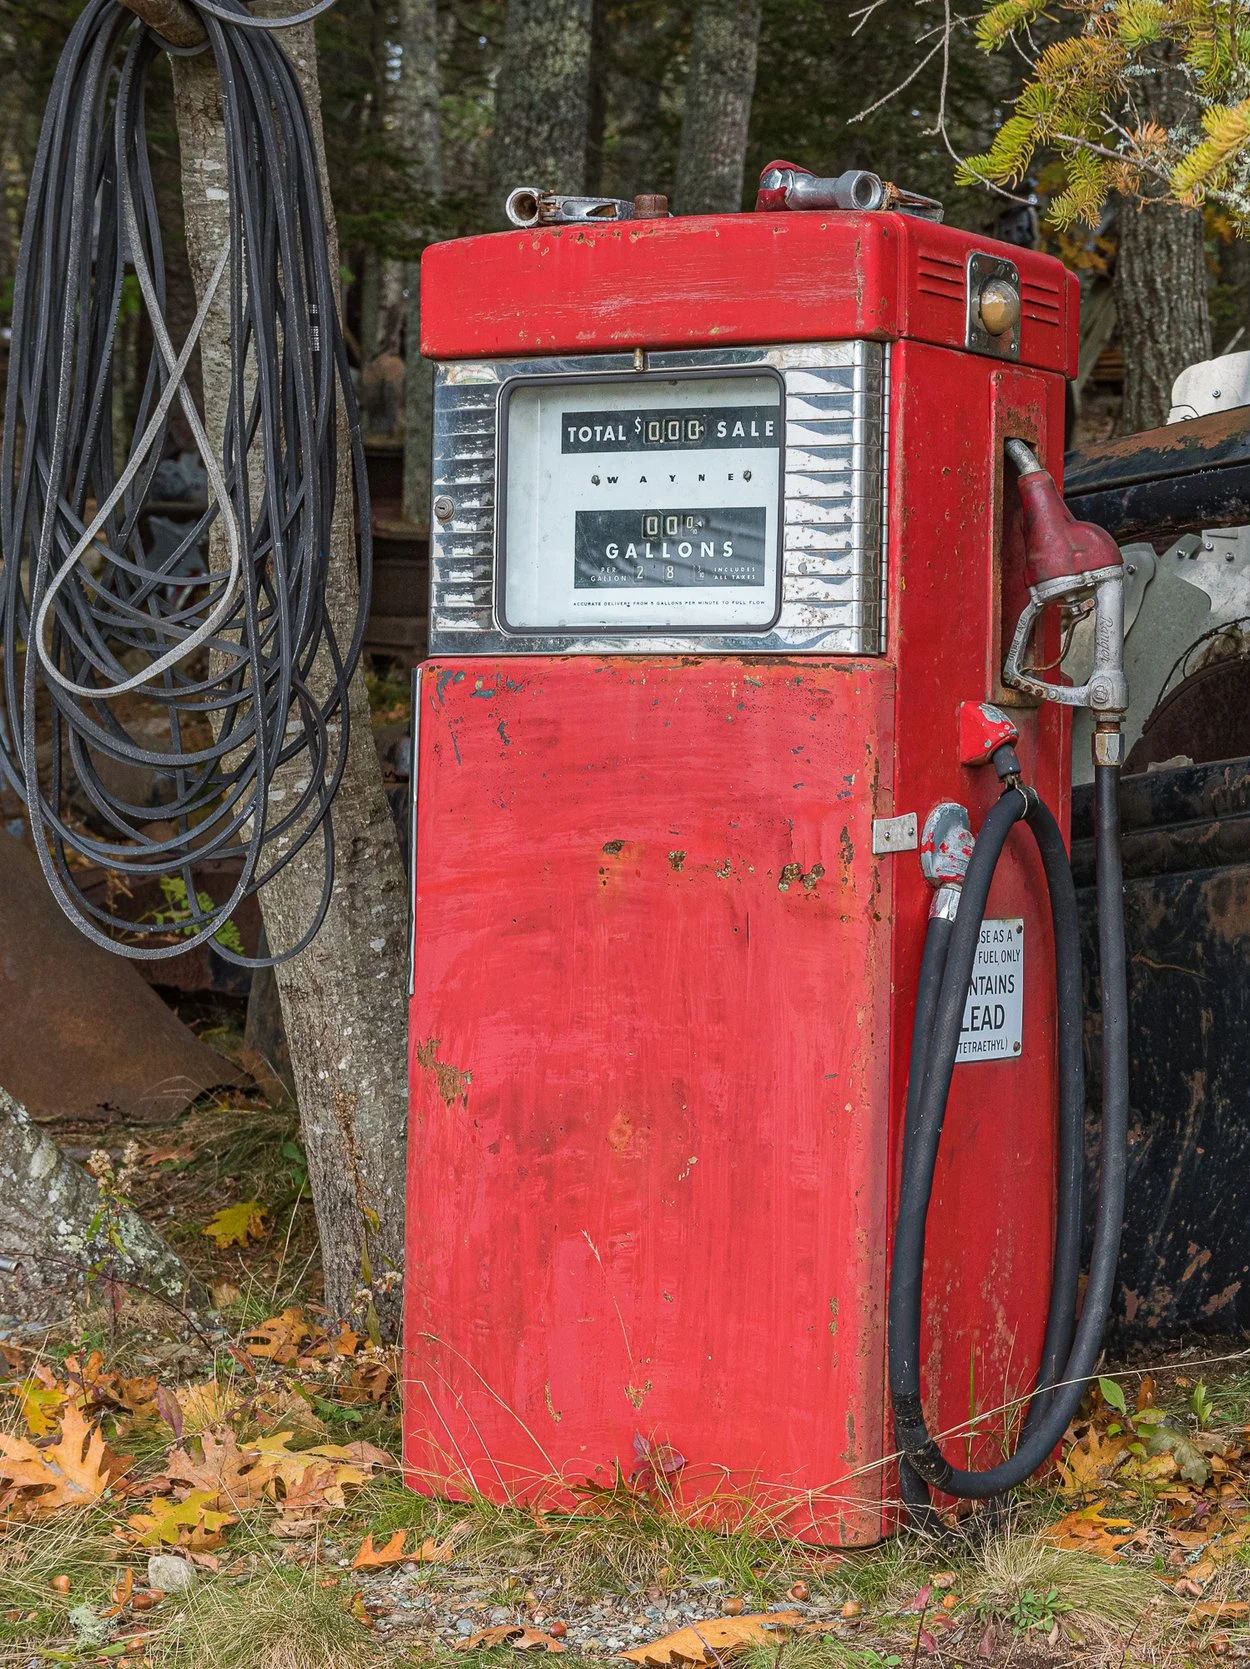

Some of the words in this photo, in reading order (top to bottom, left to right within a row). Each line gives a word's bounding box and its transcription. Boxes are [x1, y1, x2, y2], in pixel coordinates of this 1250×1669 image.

[568, 425, 626, 442] TOTAL
[717, 420, 774, 438] SALE
[606, 473, 734, 484] WAYNE
[605, 541, 733, 559] GALLONS
[1097, 616, 1114, 664] Ranger
[993, 929, 1005, 943] AS
[1006, 929, 1013, 943] A
[1000, 949, 1021, 963] ONLY
[969, 974, 1015, 996] NTAINS
[958, 1036, 1008, 1054] TETRAETHYL)
